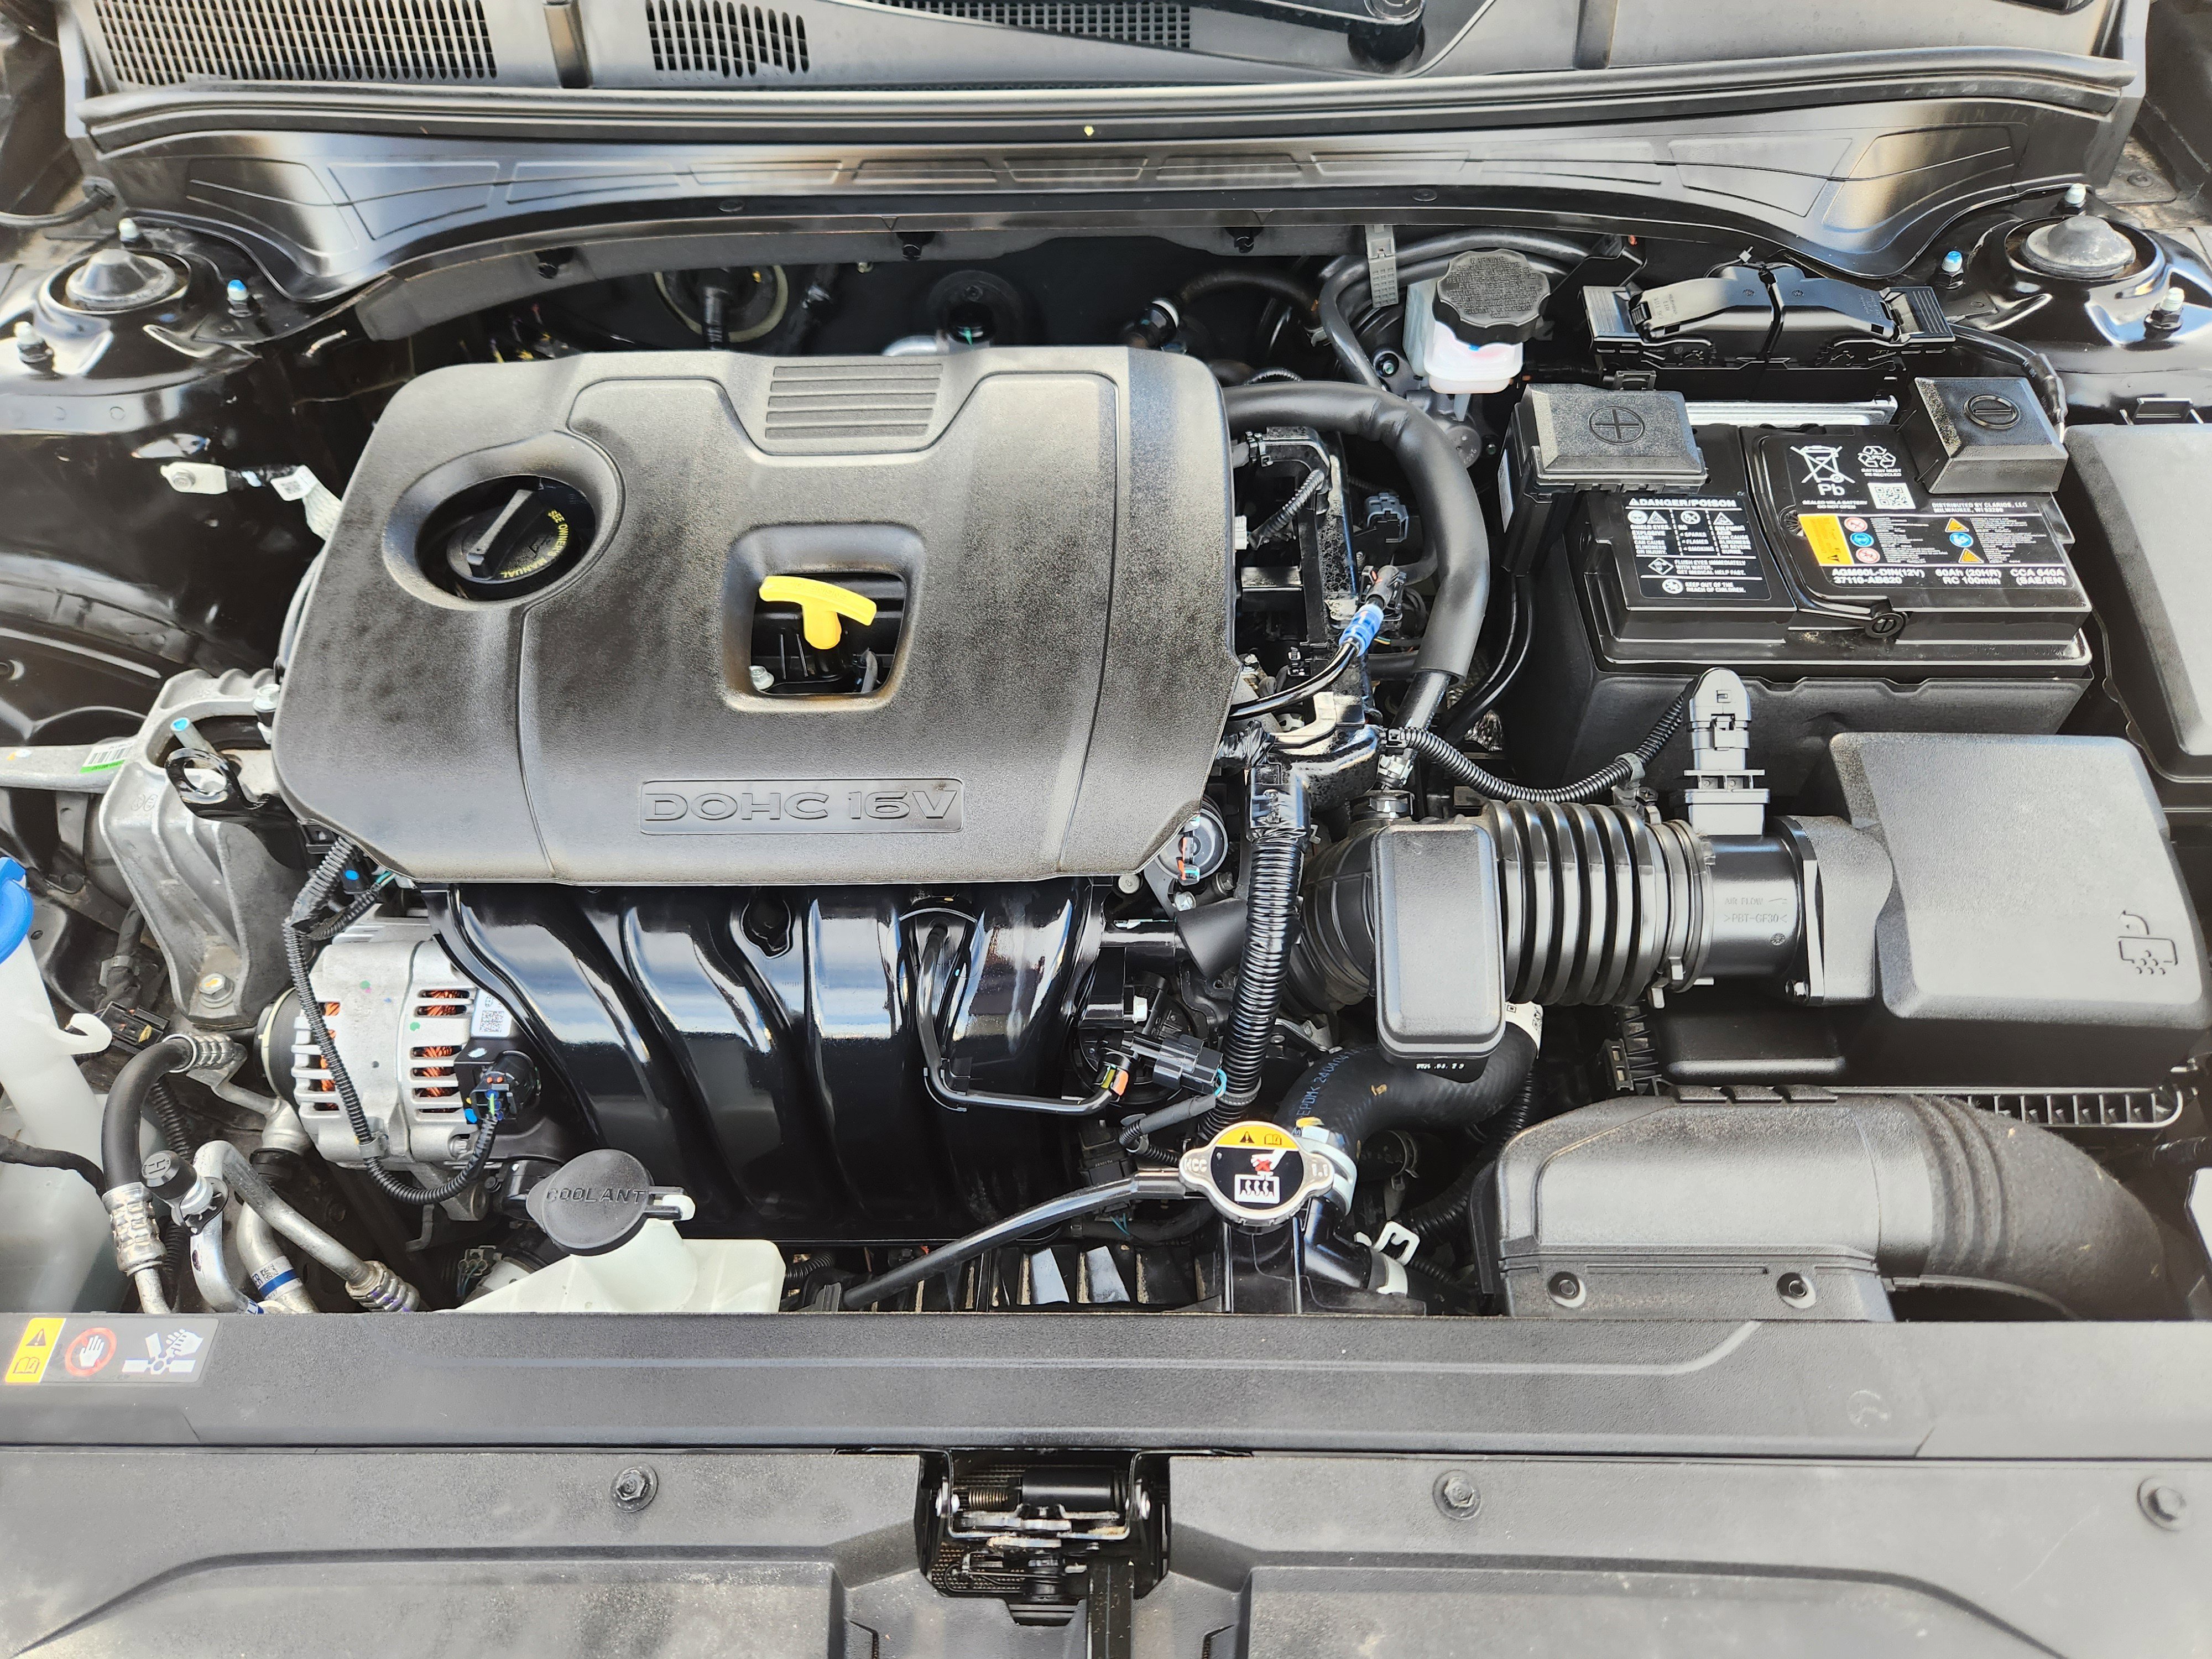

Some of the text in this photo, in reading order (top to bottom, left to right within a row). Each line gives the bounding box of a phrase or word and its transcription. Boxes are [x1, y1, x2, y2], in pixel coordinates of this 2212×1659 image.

[1817, 483, 1845, 496] Pb
[1639, 499, 1737, 508] DANGER/POISON
[499, 508, 569, 578] SEE OWNER'S MANUAL
[1832, 568, 1925, 578] AGM60L-DIN(12V)
[1965, 568, 2002, 578] (20HR)
[1961, 576, 2001, 585] 100min
[2016, 577, 2067, 586] (SAE/EN)
[644, 790, 958, 821] DOHC 16V
[1724, 897, 1764, 905] AIR FLOW
[1311, 1163, 1328, 1177] 1.1
[545, 1187, 646, 1204] COOLANT
